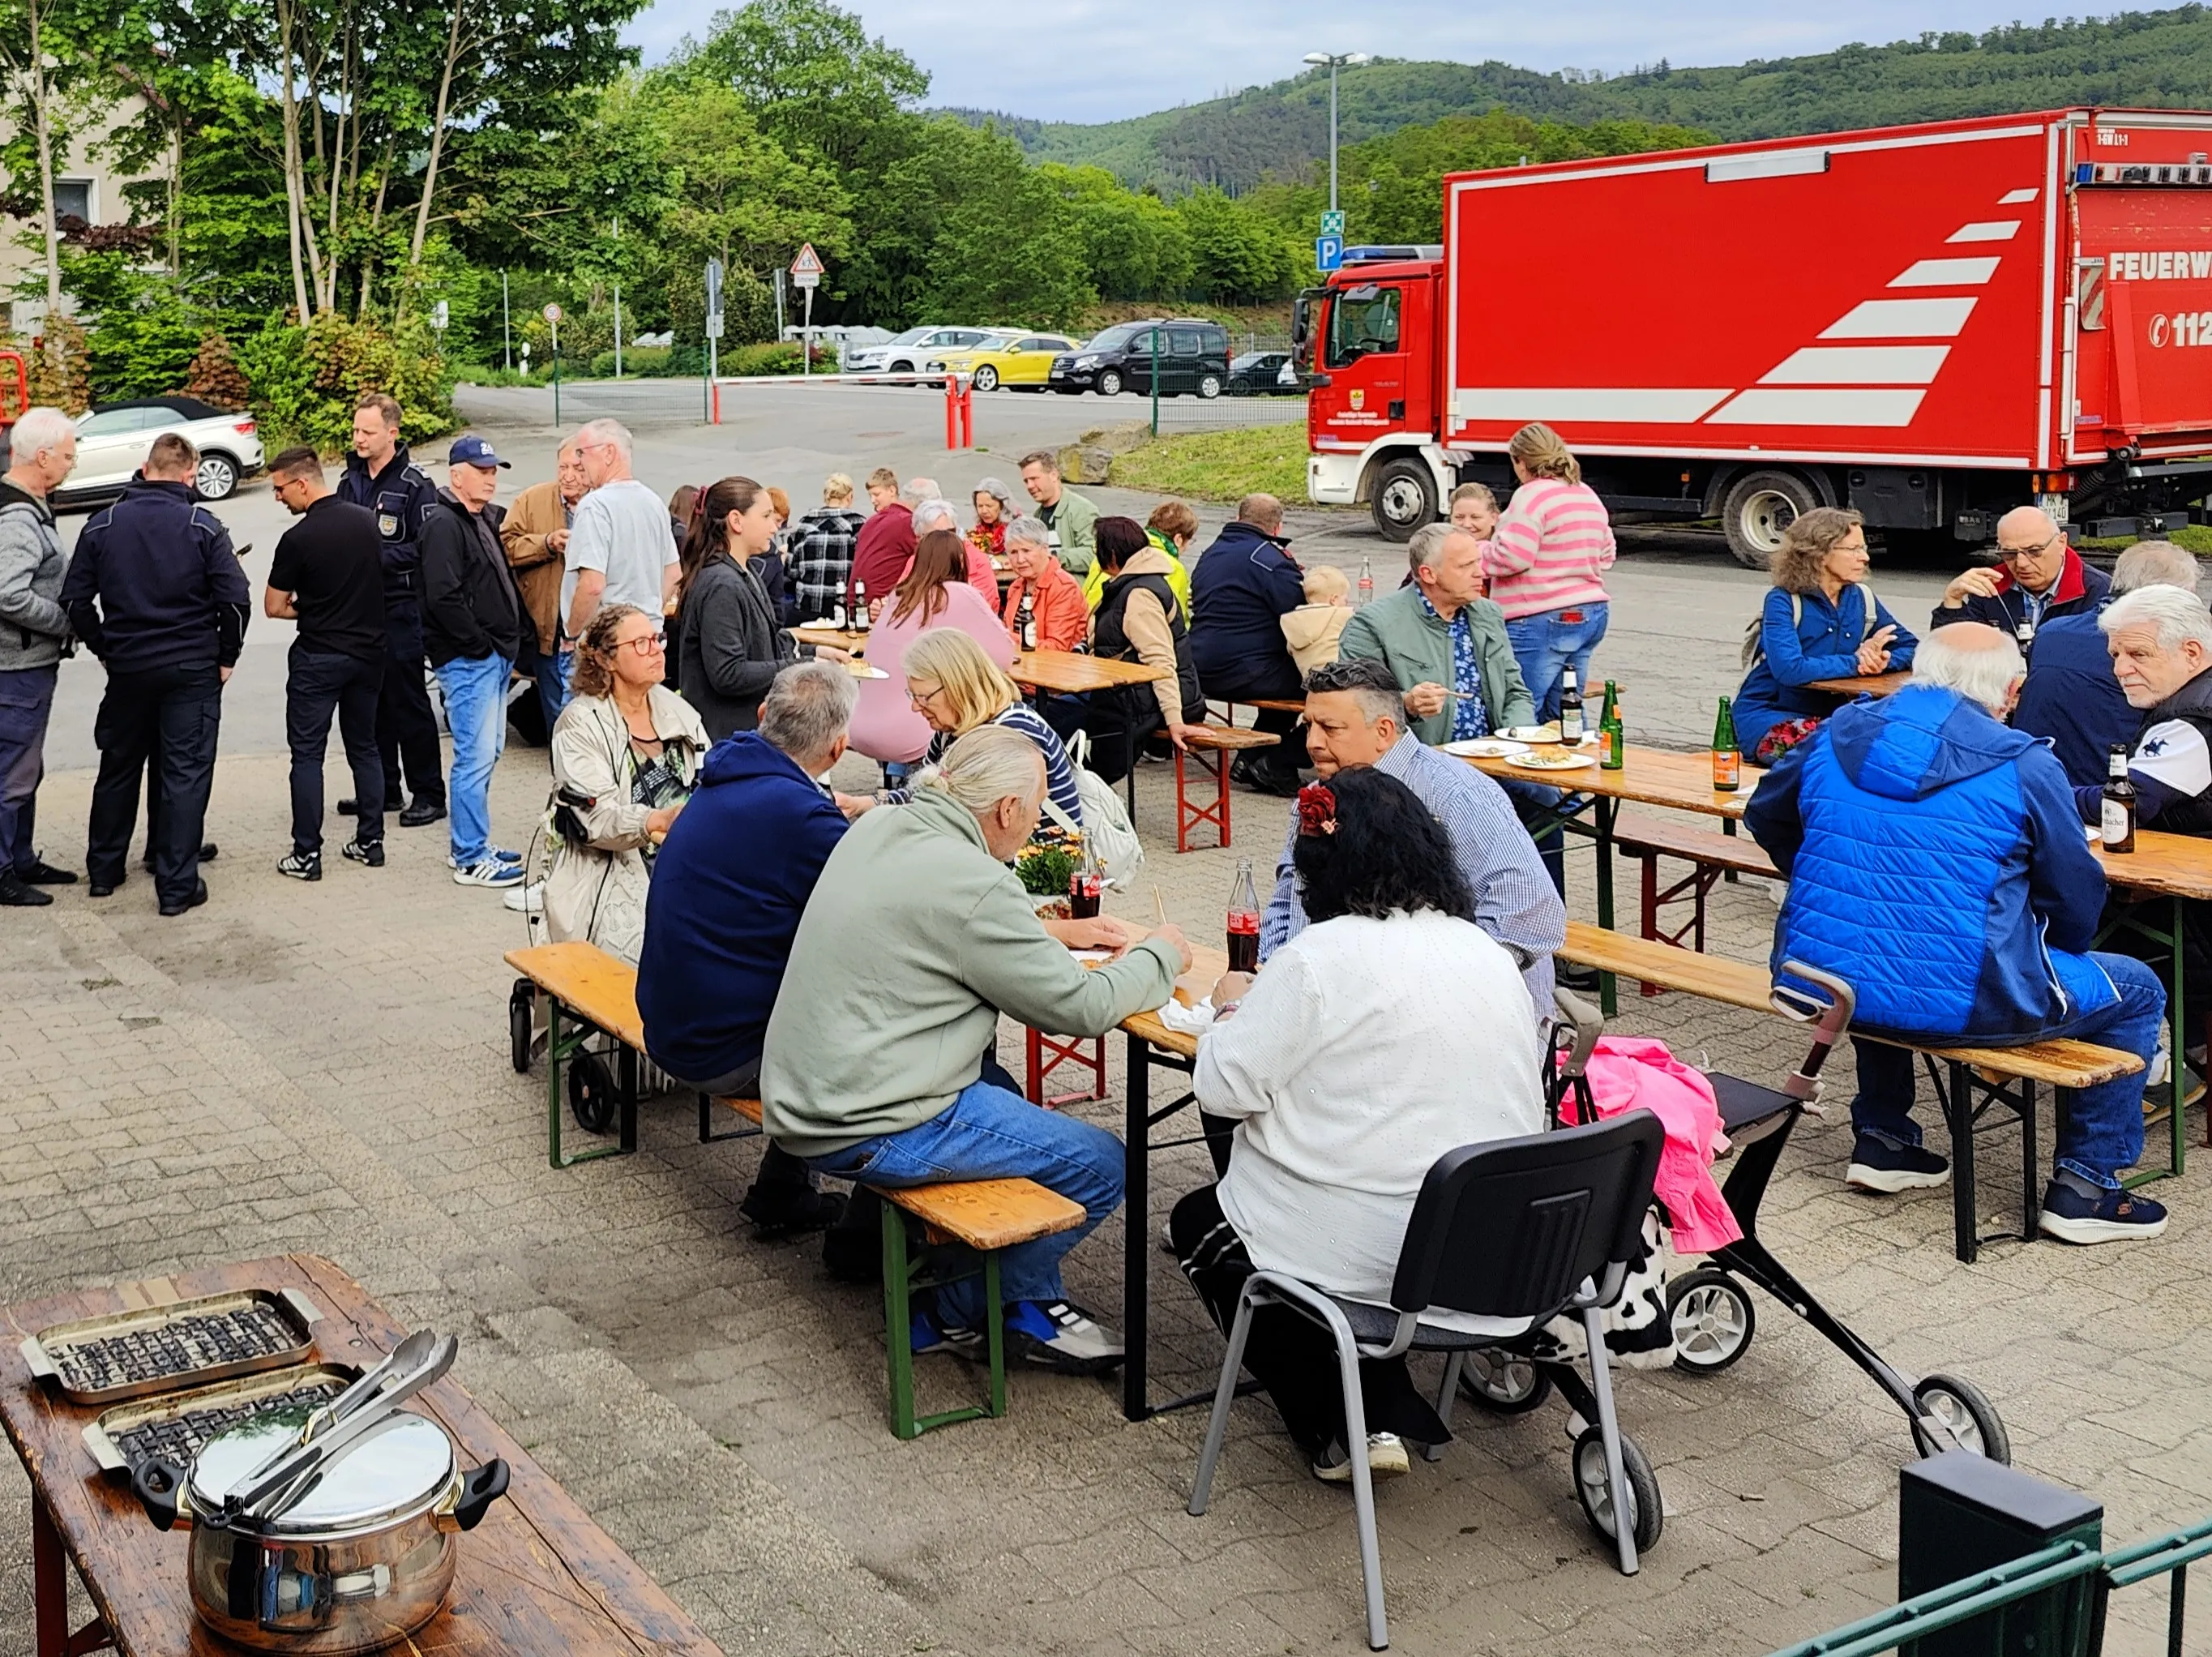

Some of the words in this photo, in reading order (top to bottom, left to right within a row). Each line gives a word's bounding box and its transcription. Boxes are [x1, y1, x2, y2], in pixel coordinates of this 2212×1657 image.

[1322, 240, 1337, 267] P
[2109, 251, 2212, 280] FEUERW
[2172, 311, 2212, 347] 112
[2047, 494, 2056, 507] MK
[2052, 507, 2066, 520] 140
